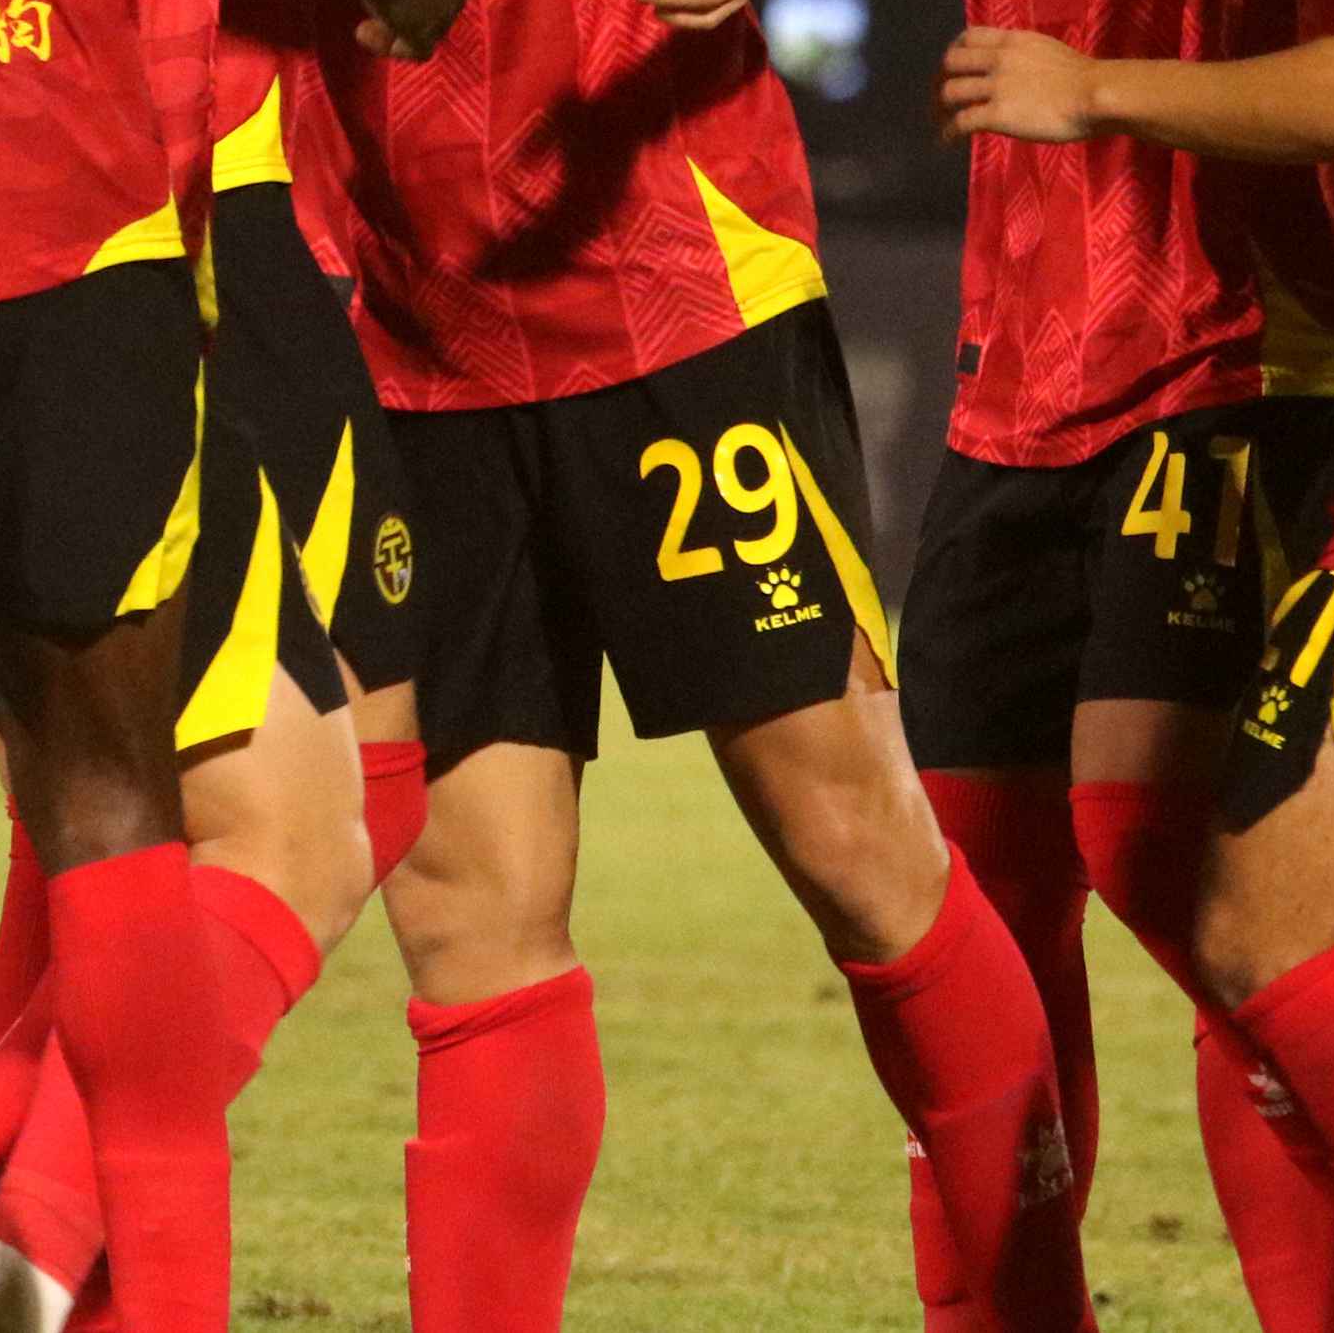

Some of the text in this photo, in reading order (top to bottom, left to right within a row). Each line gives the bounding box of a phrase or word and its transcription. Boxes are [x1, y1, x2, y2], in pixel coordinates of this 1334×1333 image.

[639, 423, 798, 582] 29
[1121, 431, 1250, 567] 41
[754, 603, 823, 633] KELME
